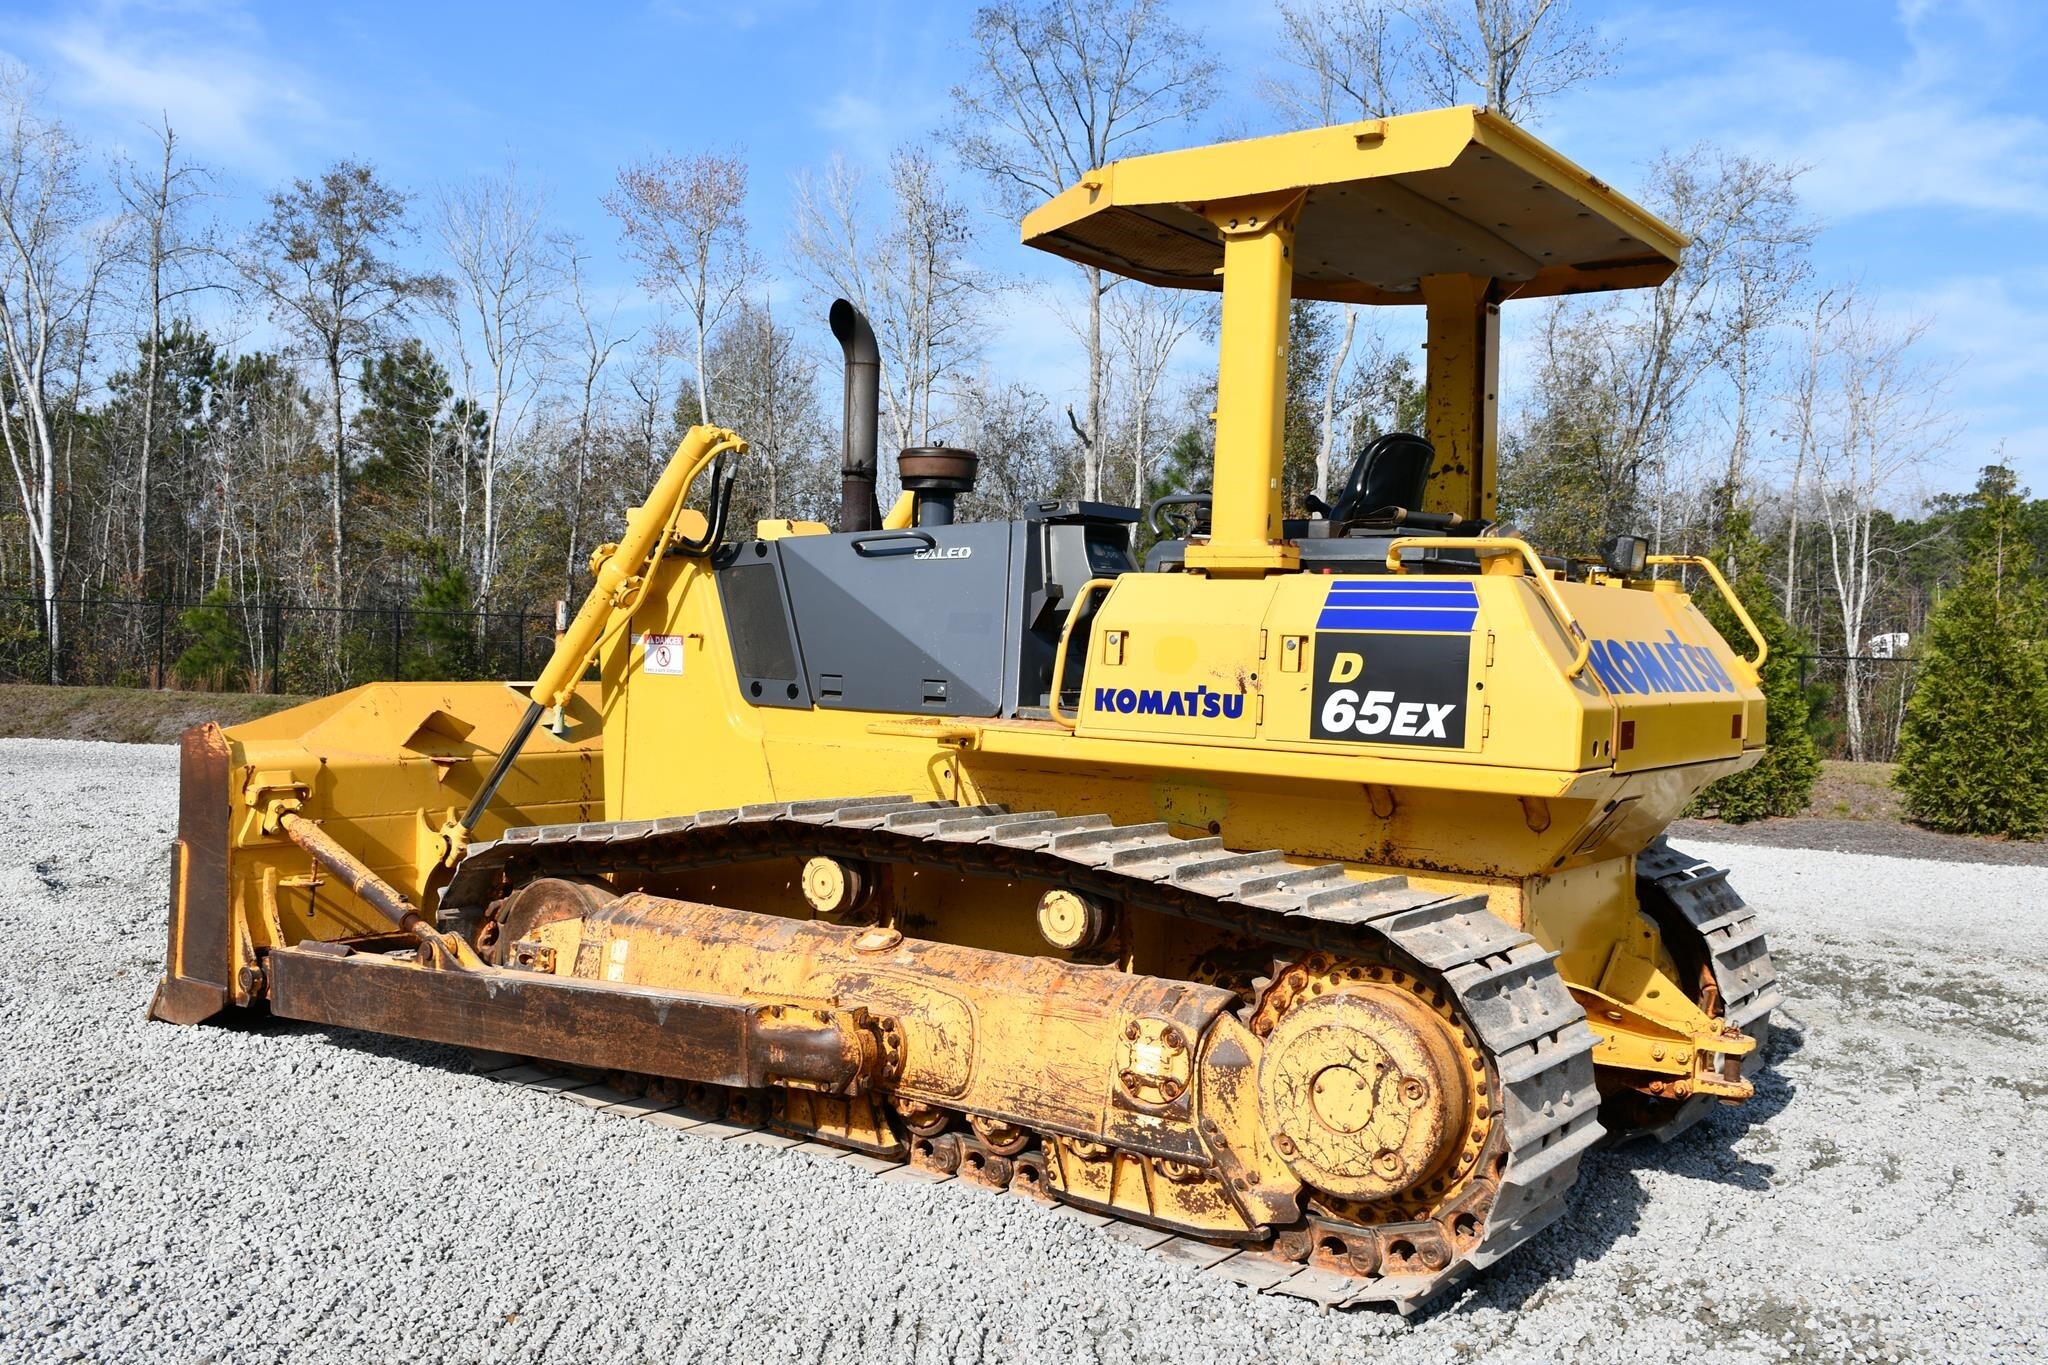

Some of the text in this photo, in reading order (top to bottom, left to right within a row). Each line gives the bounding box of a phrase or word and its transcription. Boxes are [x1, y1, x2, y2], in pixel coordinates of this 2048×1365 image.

[913, 547, 972, 559] GALEO
[655, 636, 682, 645] DANGER
[1328, 652, 1364, 684] D
[1587, 629, 1736, 696] KOMATSU
[1094, 685, 1244, 719] KOMATSU
[1321, 689, 1456, 739] 65EX
